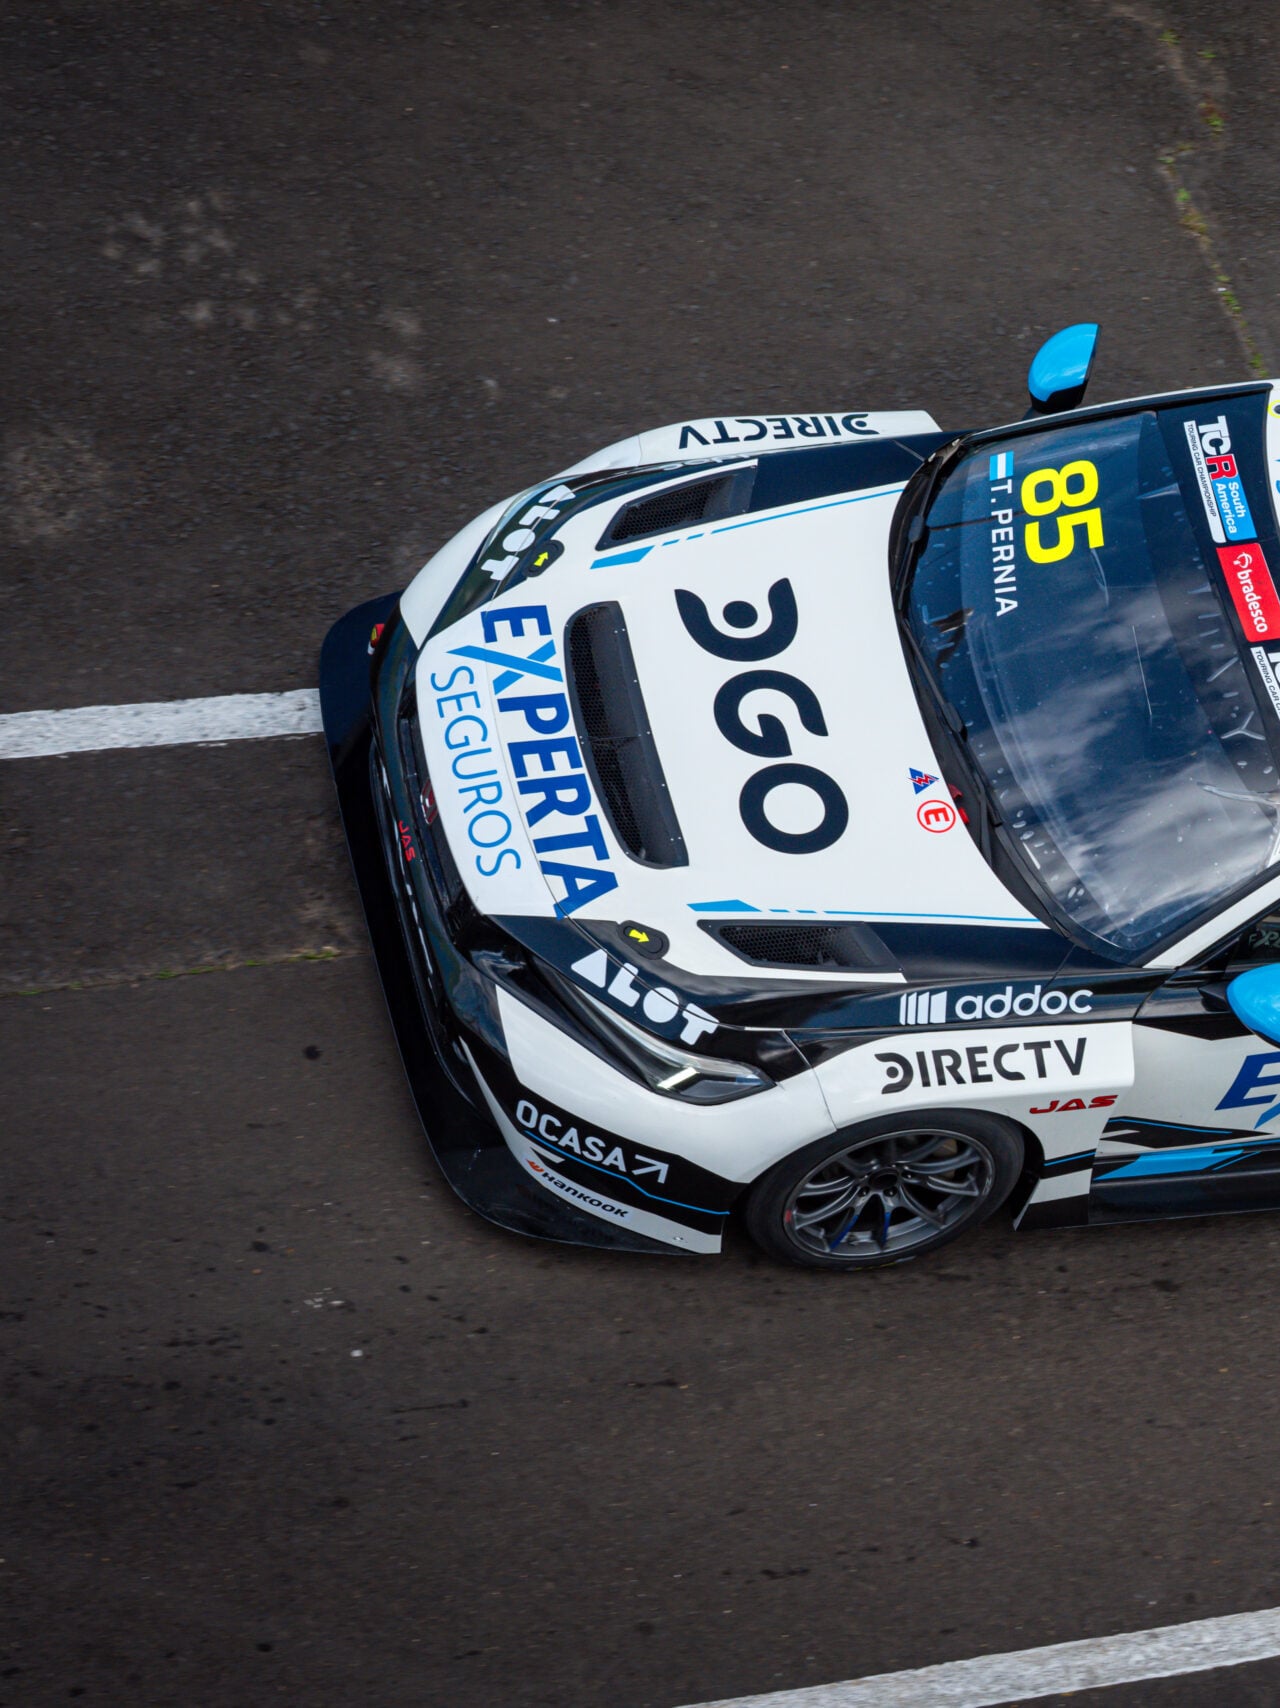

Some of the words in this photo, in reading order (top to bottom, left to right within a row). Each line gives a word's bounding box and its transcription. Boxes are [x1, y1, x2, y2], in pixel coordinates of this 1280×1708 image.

[678, 413, 880, 449] DIRECTV
[1198, 415, 1239, 480] TCR
[988, 478, 1013, 506] T.
[1187, 423, 1199, 454] TOURING
[1194, 452, 1202, 467] CAR
[1198, 466, 1217, 517] CHAMPIONSHIP
[1228, 481, 1247, 518] South
[481, 485, 577, 582] ALOT
[1020, 459, 1105, 565] 85
[1215, 482, 1238, 534] America
[990, 507, 1018, 617] PERNIA
[1237, 569, 1269, 634] bradesco
[1255, 649, 1273, 683] TOURING
[1268, 684, 1280, 703] CAR
[675, 577, 850, 855] DGO
[430, 665, 522, 878] SEGUROS
[447, 604, 620, 921] EXPERTA
[397, 819, 416, 863] JAS
[571, 949, 719, 1046] ALOT
[955, 985, 1093, 1021] addoc
[874, 1037, 1088, 1095] DIRECTV
[516, 1100, 627, 1173] OCASA
[1029, 1094, 1119, 1115] JAS
